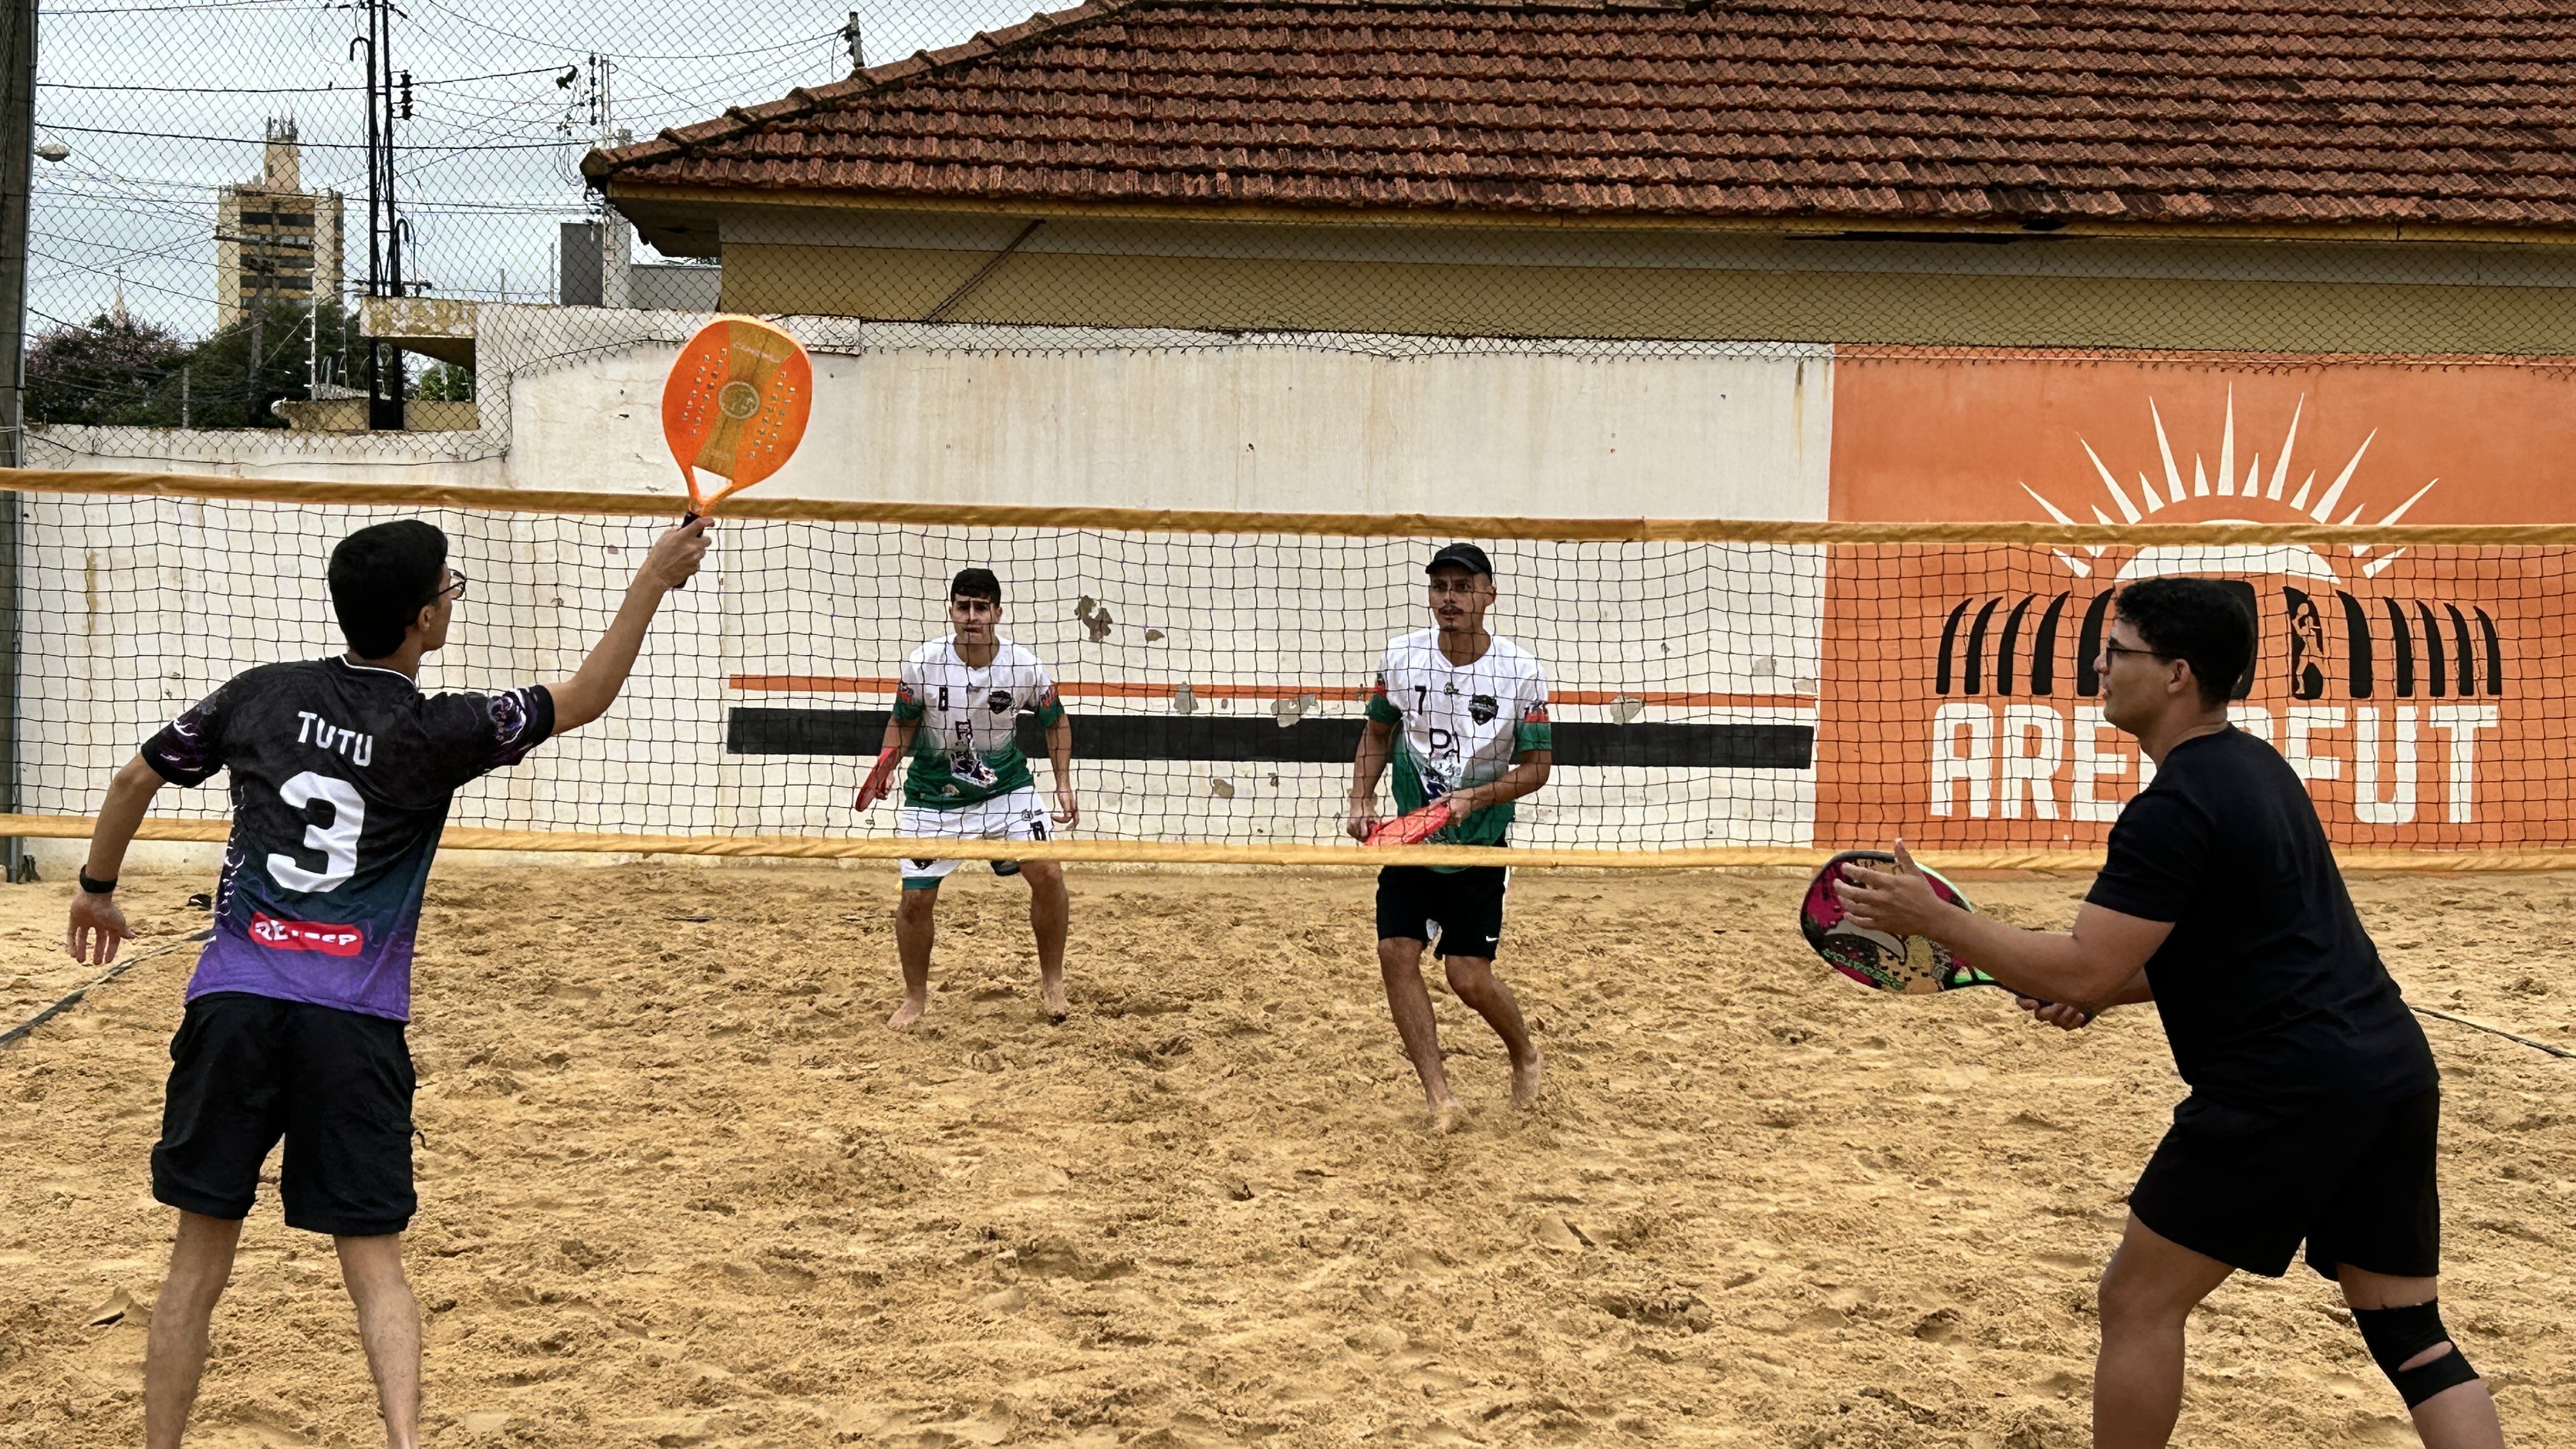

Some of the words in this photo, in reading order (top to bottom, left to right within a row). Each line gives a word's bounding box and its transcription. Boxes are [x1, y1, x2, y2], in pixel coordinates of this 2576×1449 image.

[939, 687, 949, 711] 8
[1414, 686, 1427, 715] 7
[298, 710, 372, 767] TUTU
[1930, 703, 2499, 824] AREFUT
[267, 771, 365, 893] 3
